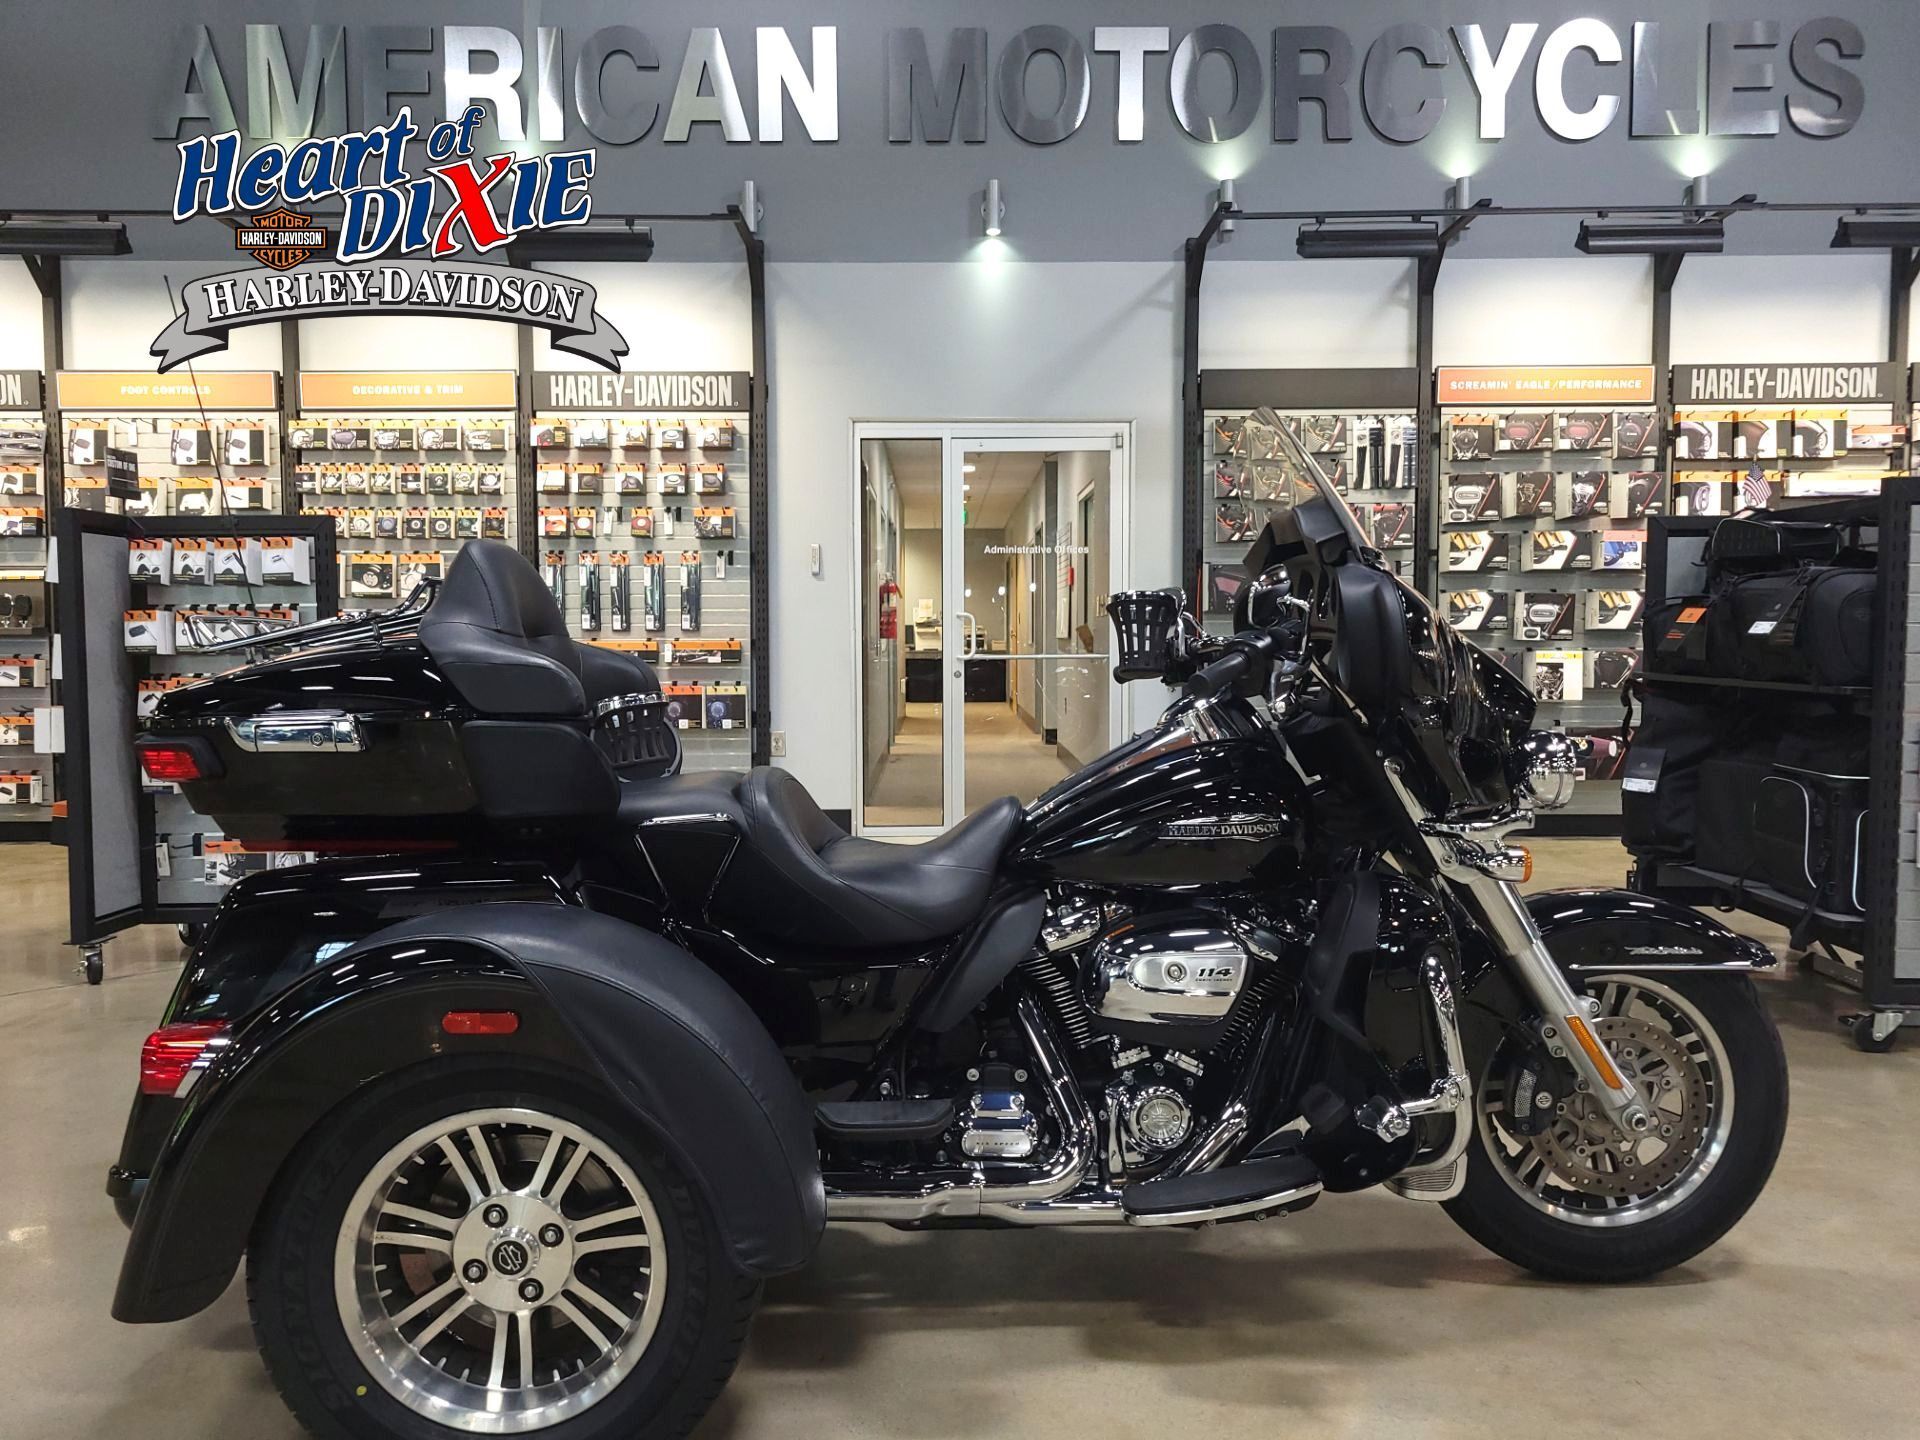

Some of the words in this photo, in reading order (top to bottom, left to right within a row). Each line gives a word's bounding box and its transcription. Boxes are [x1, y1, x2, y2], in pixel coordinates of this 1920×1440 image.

[152, 22, 839, 144] AMERICAN
[888, 16, 1866, 142] MOTORCYCLES
[1450, 380, 1511, 391] SCREAMIN'
[1690, 366, 1878, 400] HARLEY-DAVIDSON
[121, 385, 149, 395] FOOT
[152, 384, 212, 395] CONTROLS
[352, 385, 421, 395] DECORATIVE
[436, 384, 465, 394] TRIM
[550, 374, 733, 407] HARLEY-DAVIDSON
[983, 544, 1052, 554] Administrative
[1054, 545, 1090, 554] Offices
[1168, 822, 1280, 836] HARLEY-DAVIDSON
[1198, 968, 1232, 977] 114
